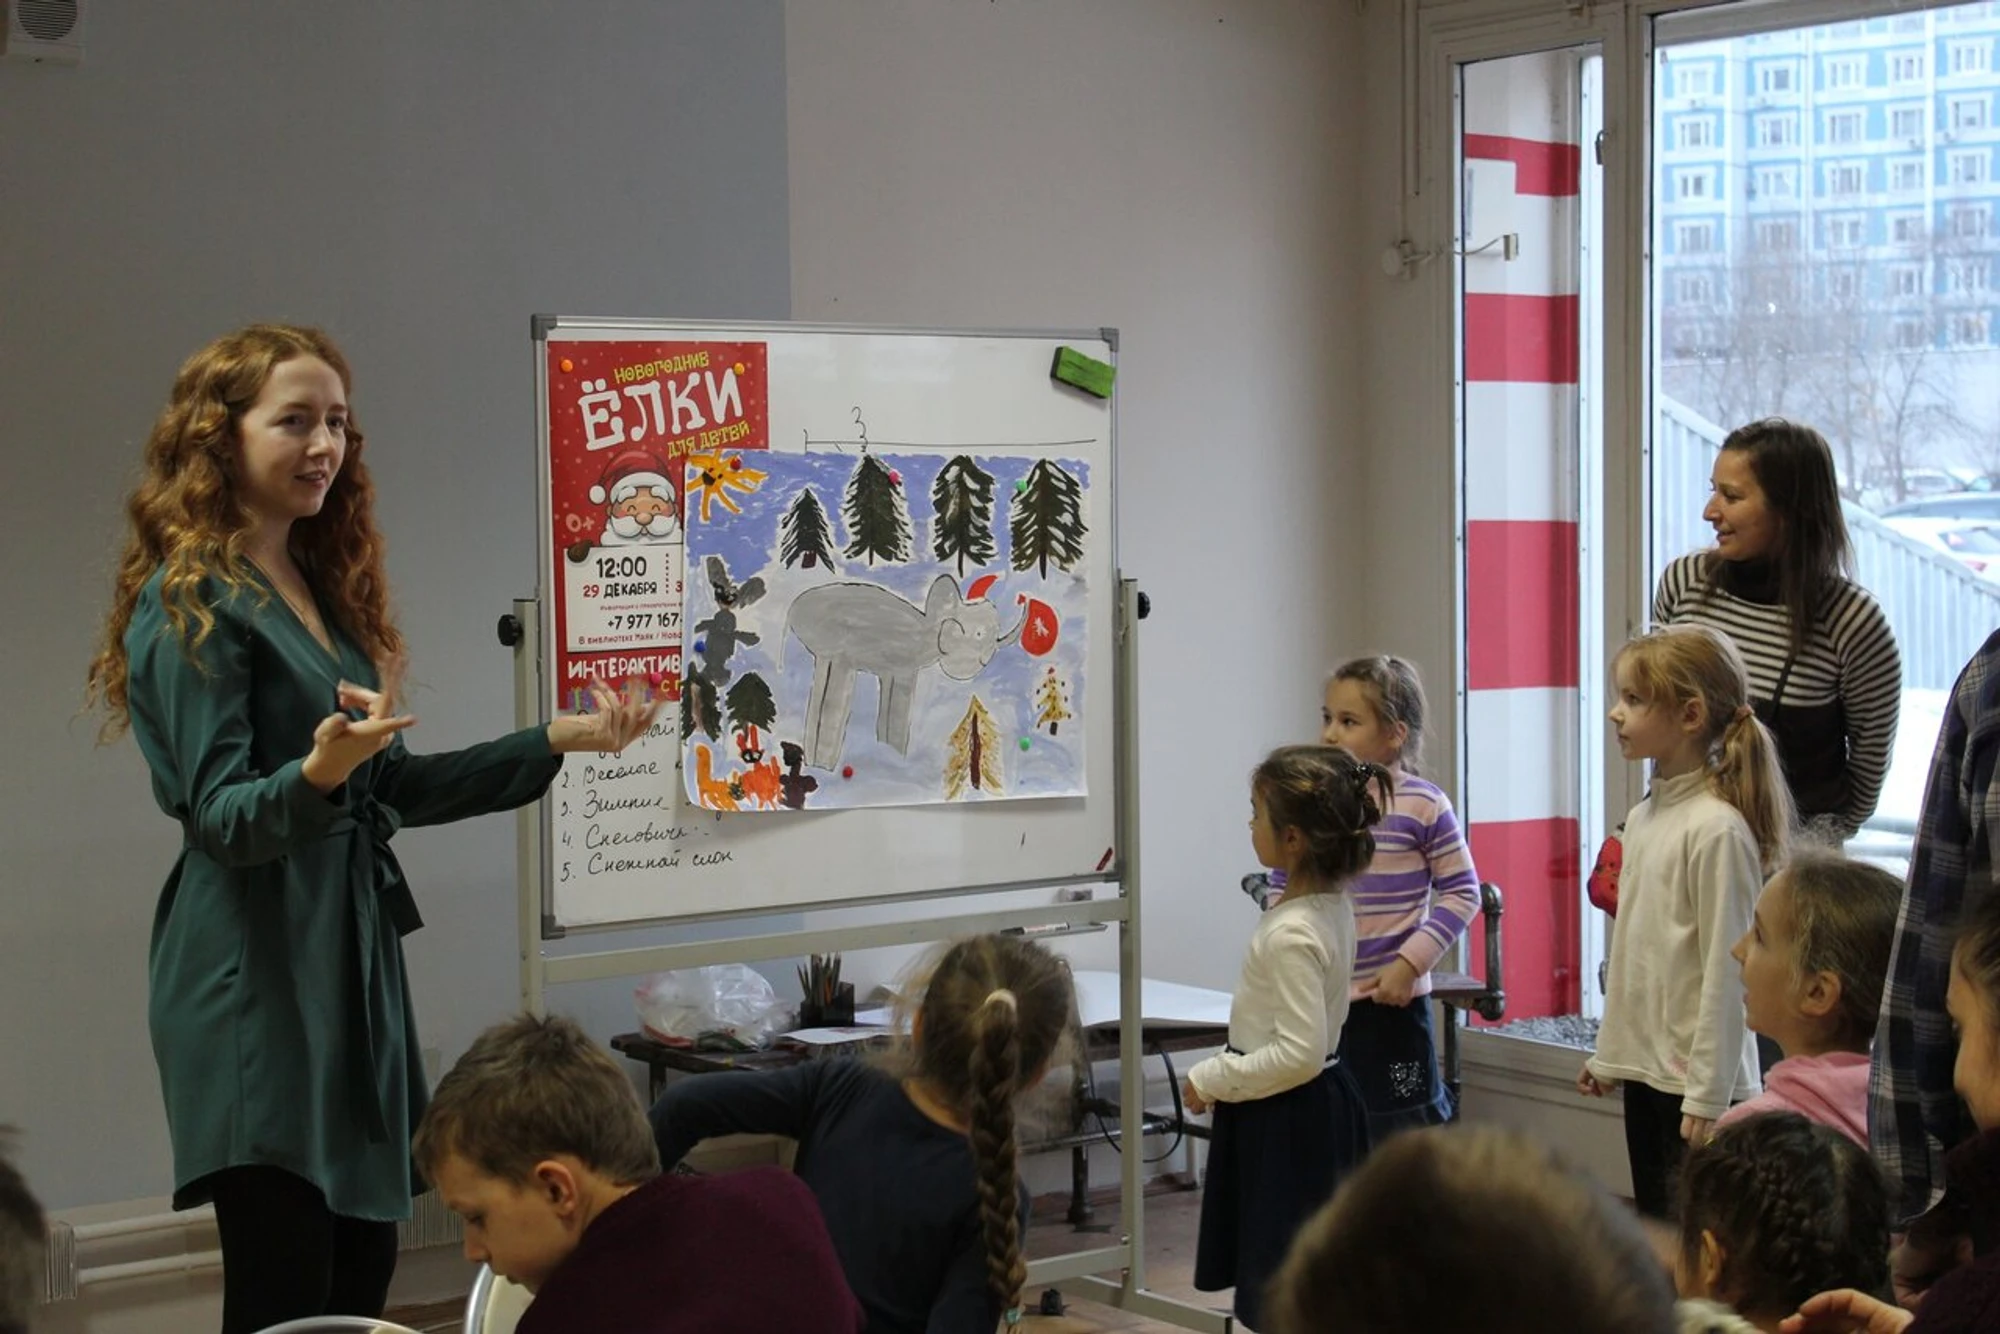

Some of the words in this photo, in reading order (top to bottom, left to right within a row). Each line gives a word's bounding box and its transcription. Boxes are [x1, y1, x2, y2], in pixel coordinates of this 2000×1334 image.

[614, 350, 709, 384] НОВОГОДНИЕ
[578, 368, 743, 450] ЁЛКИ
[667, 436, 696, 460] ДЛЯ
[700, 420, 750, 448] ДЕТЕЙ
[596, 556, 647, 579] 12:00
[583, 585, 600, 598] 29
[603, 582, 657, 599] ДЕКАБРЯ
[607, 616, 623, 630] +7
[626, 613, 652, 630] 977
[568, 653, 681, 680] ИНТЕРАКТИВ
